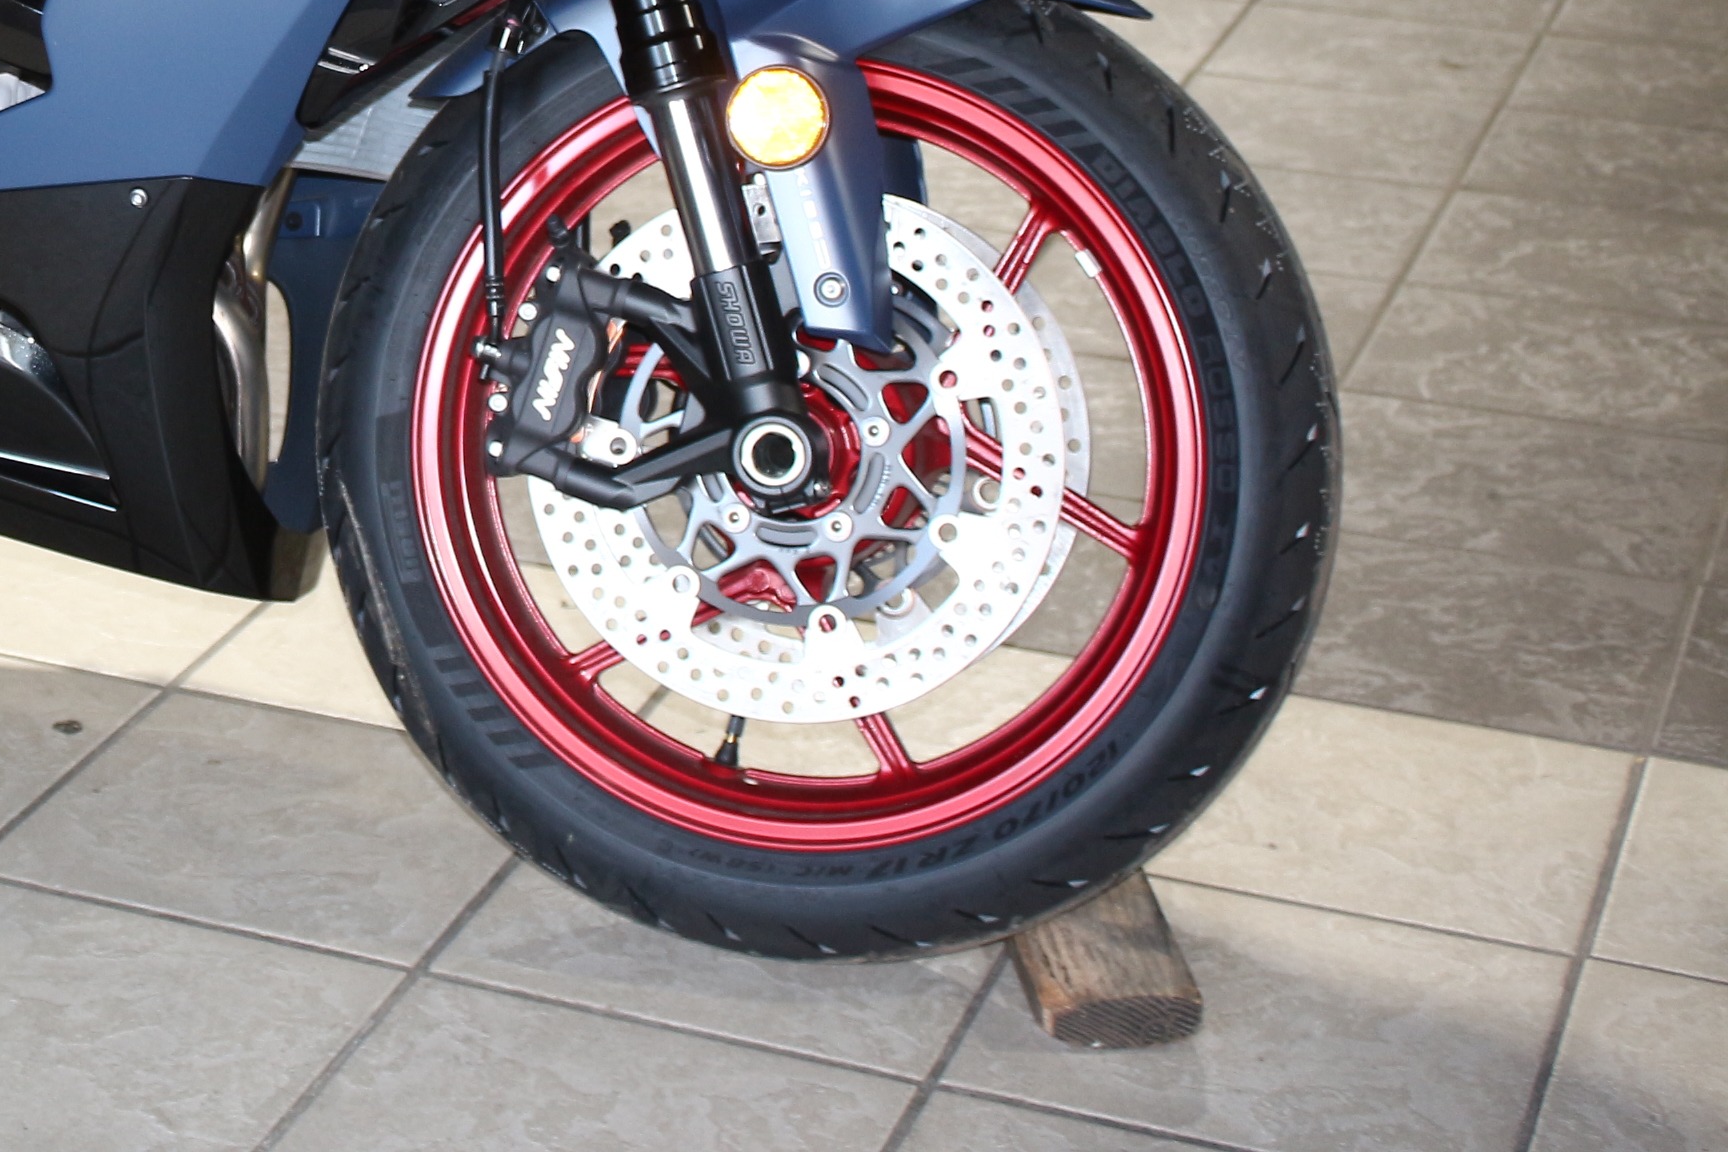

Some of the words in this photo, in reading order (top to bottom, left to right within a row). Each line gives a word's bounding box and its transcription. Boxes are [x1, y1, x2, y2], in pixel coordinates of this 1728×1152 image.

[716, 281, 756, 365] SHOWA
[1092, 151, 1208, 316] DIABLO
[1198, 334, 1236, 492] ROSSO
[992, 740, 1119, 843] 120/70
